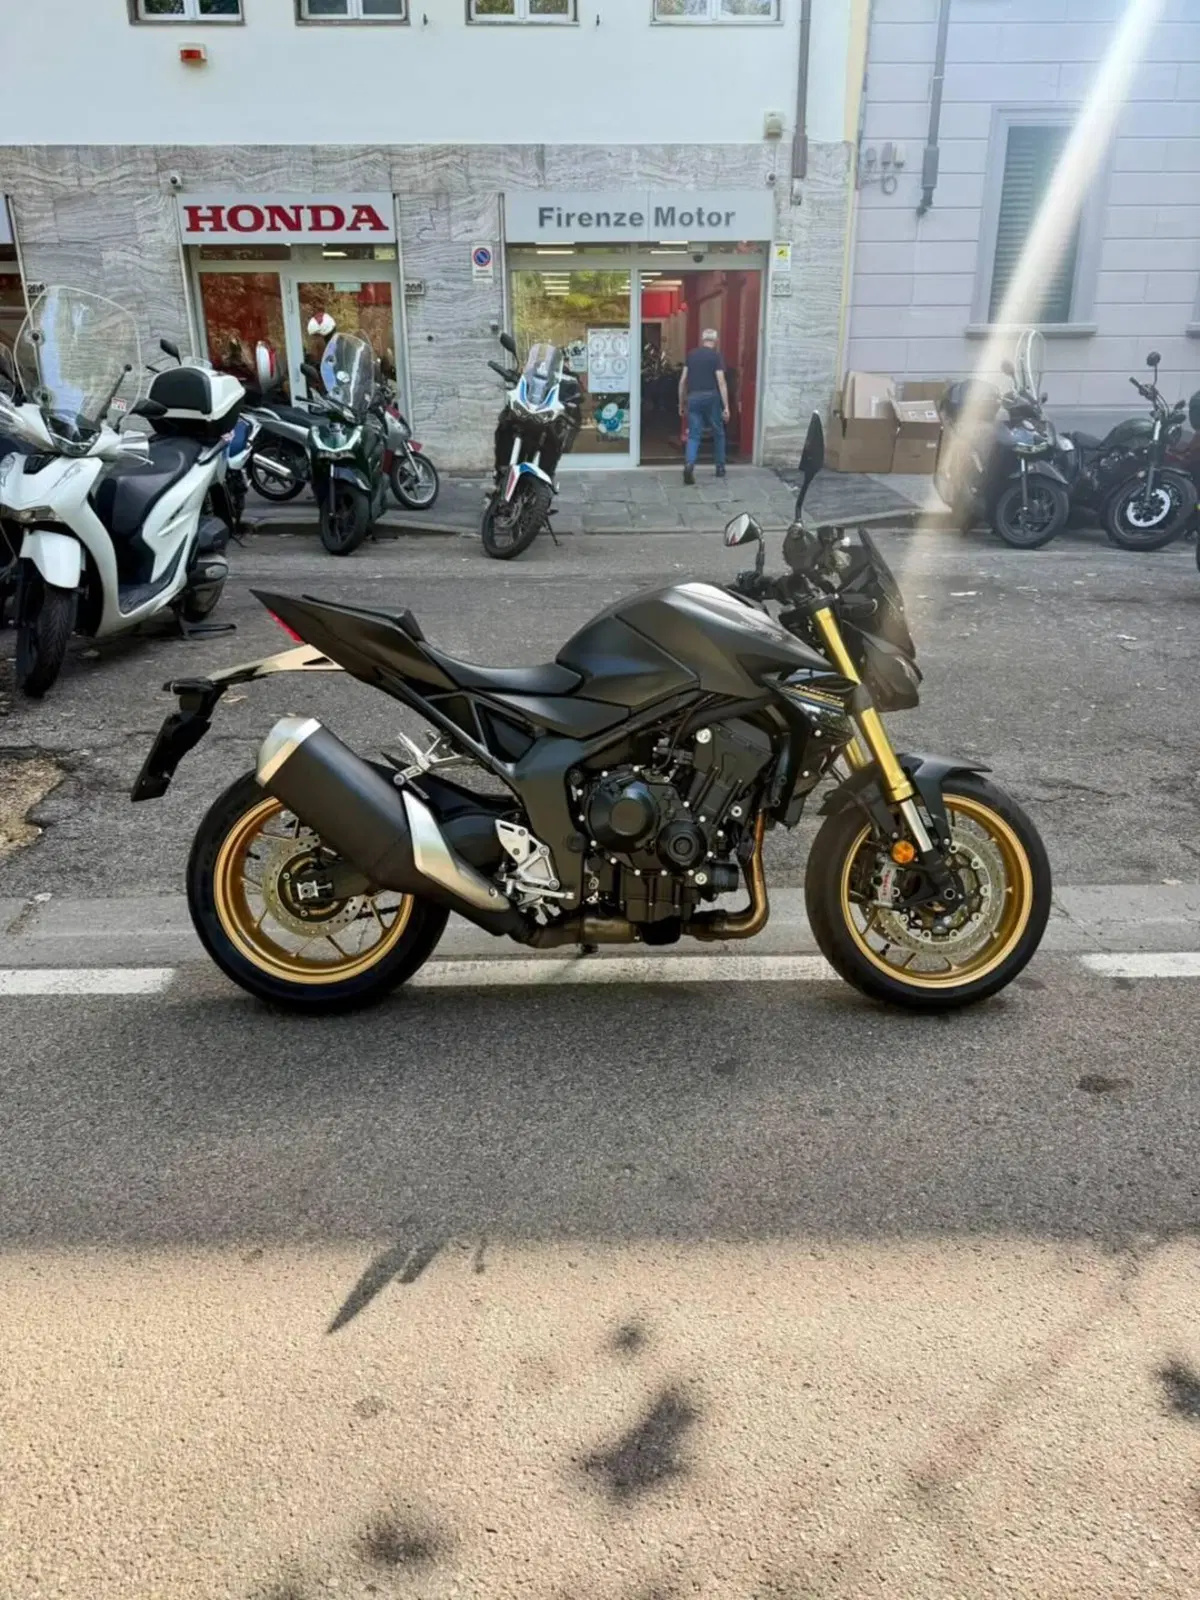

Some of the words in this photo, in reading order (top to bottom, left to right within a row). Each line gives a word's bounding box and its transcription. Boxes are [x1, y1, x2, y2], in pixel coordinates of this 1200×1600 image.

[183, 204, 389, 232] HONDA
[538, 206, 644, 227] Firenze
[654, 206, 736, 227] Motor
